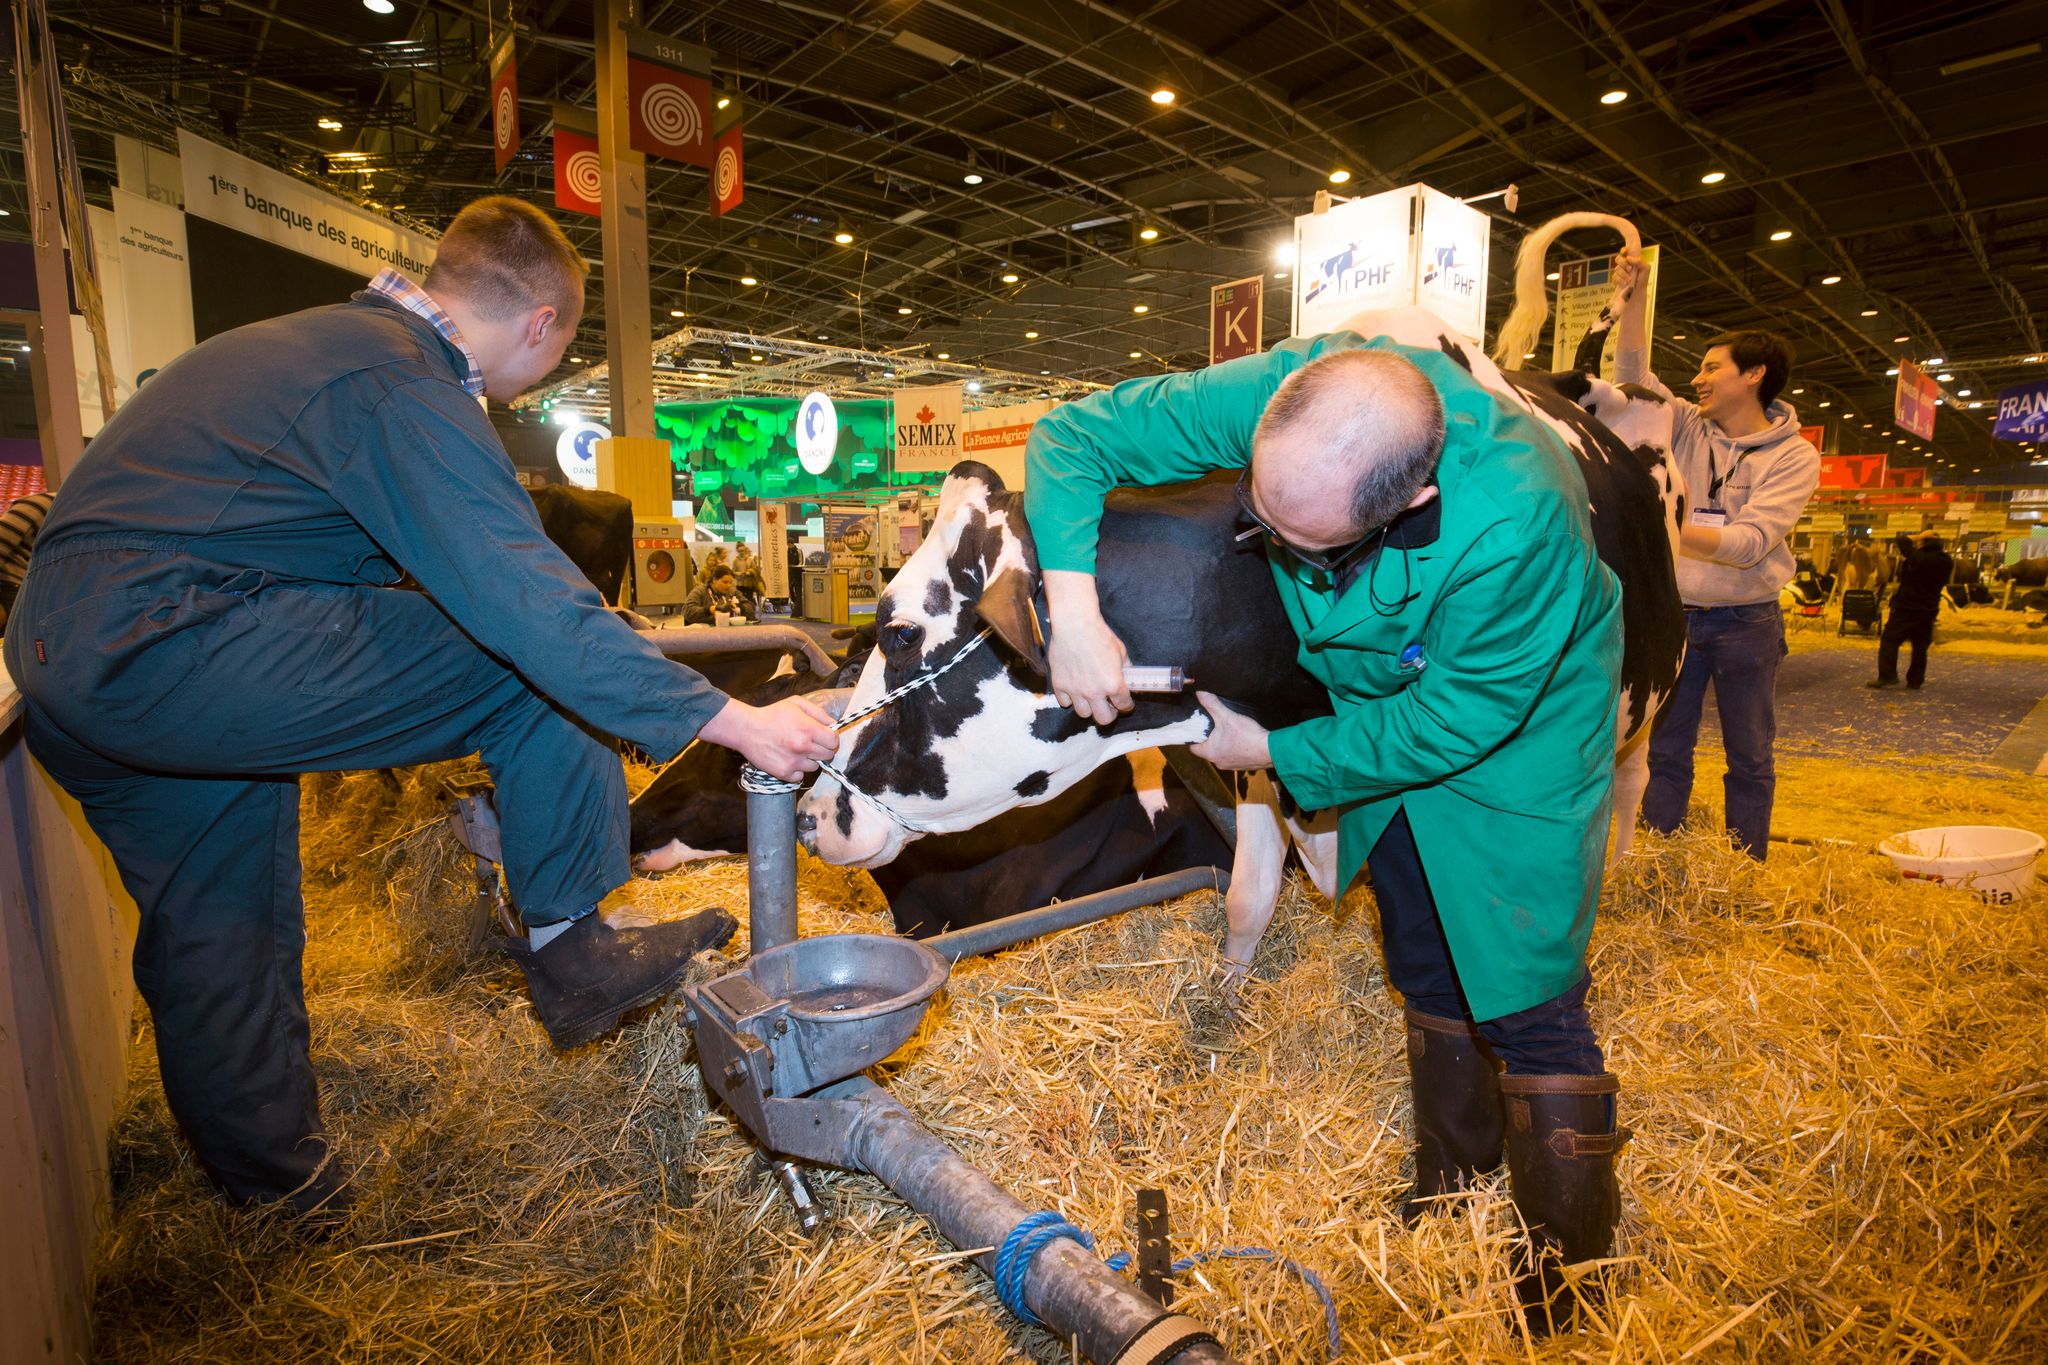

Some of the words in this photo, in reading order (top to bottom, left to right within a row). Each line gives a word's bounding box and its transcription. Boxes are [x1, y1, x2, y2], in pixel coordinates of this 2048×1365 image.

[655, 44, 683, 62] 1311
[208, 174, 238, 195] 1ère
[243, 187, 313, 231] banque
[317, 219, 347, 245] des
[351, 234, 432, 277] agriculteurs
[120, 236, 136, 246] des
[138, 240, 184, 261] agriculteurs
[143, 230, 173, 246] banque
[1354, 262, 1394, 288] PHF
[1453, 273, 1475, 296] PHF
[1573, 264, 1582, 285] 1
[1225, 306, 1248, 346] K
[898, 424, 956, 446] SEMEX
[965, 435, 974, 447] La
[975, 433, 1001, 446] France
[899, 449, 959, 457] FRANCE
[770, 528, 782, 595] swissgenetics
